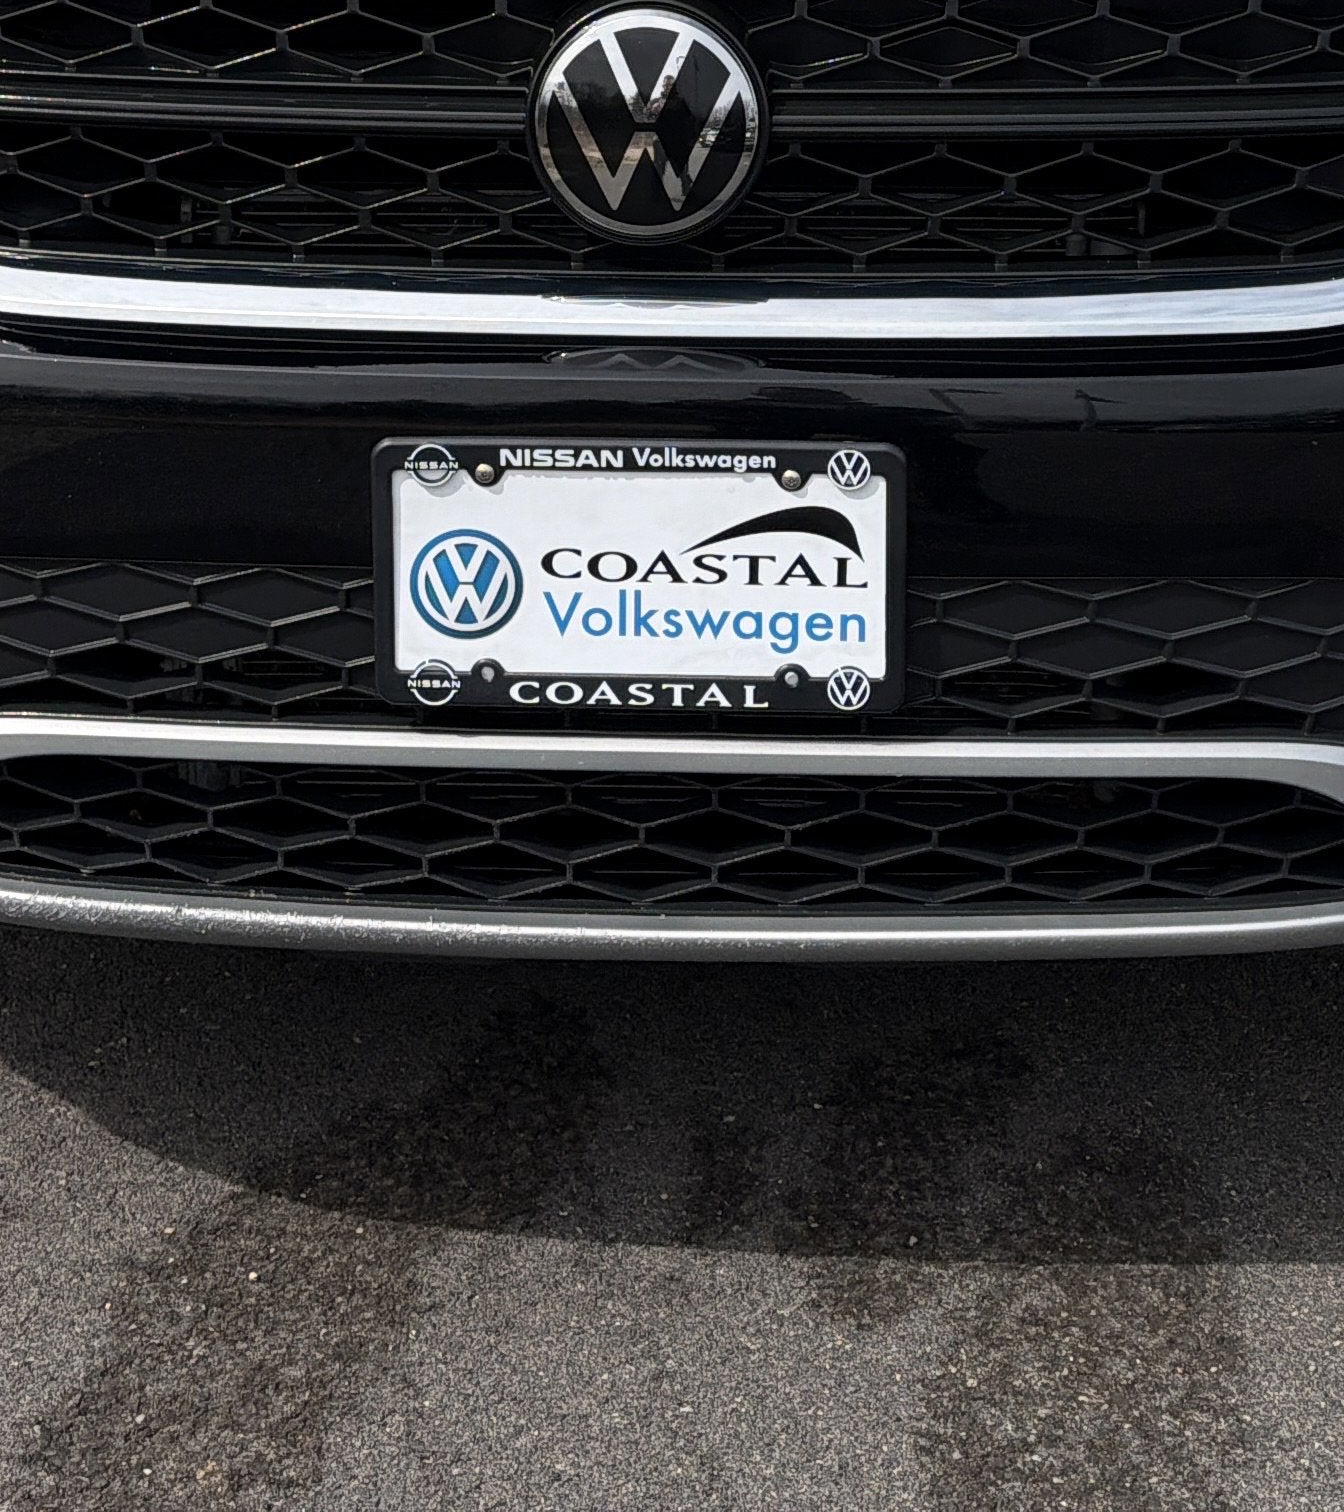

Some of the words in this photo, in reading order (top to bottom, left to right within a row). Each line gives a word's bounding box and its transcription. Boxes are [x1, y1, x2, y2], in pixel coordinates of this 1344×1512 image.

[404, 460, 459, 471] NISSAN
[499, 448, 624, 468] NISSAN
[632, 447, 777, 471] Volkswagen
[540, 548, 868, 589] COASTAL
[543, 589, 867, 654] Volkswagen
[407, 678, 461, 689] NISSAN
[509, 679, 770, 709] COASTAL
